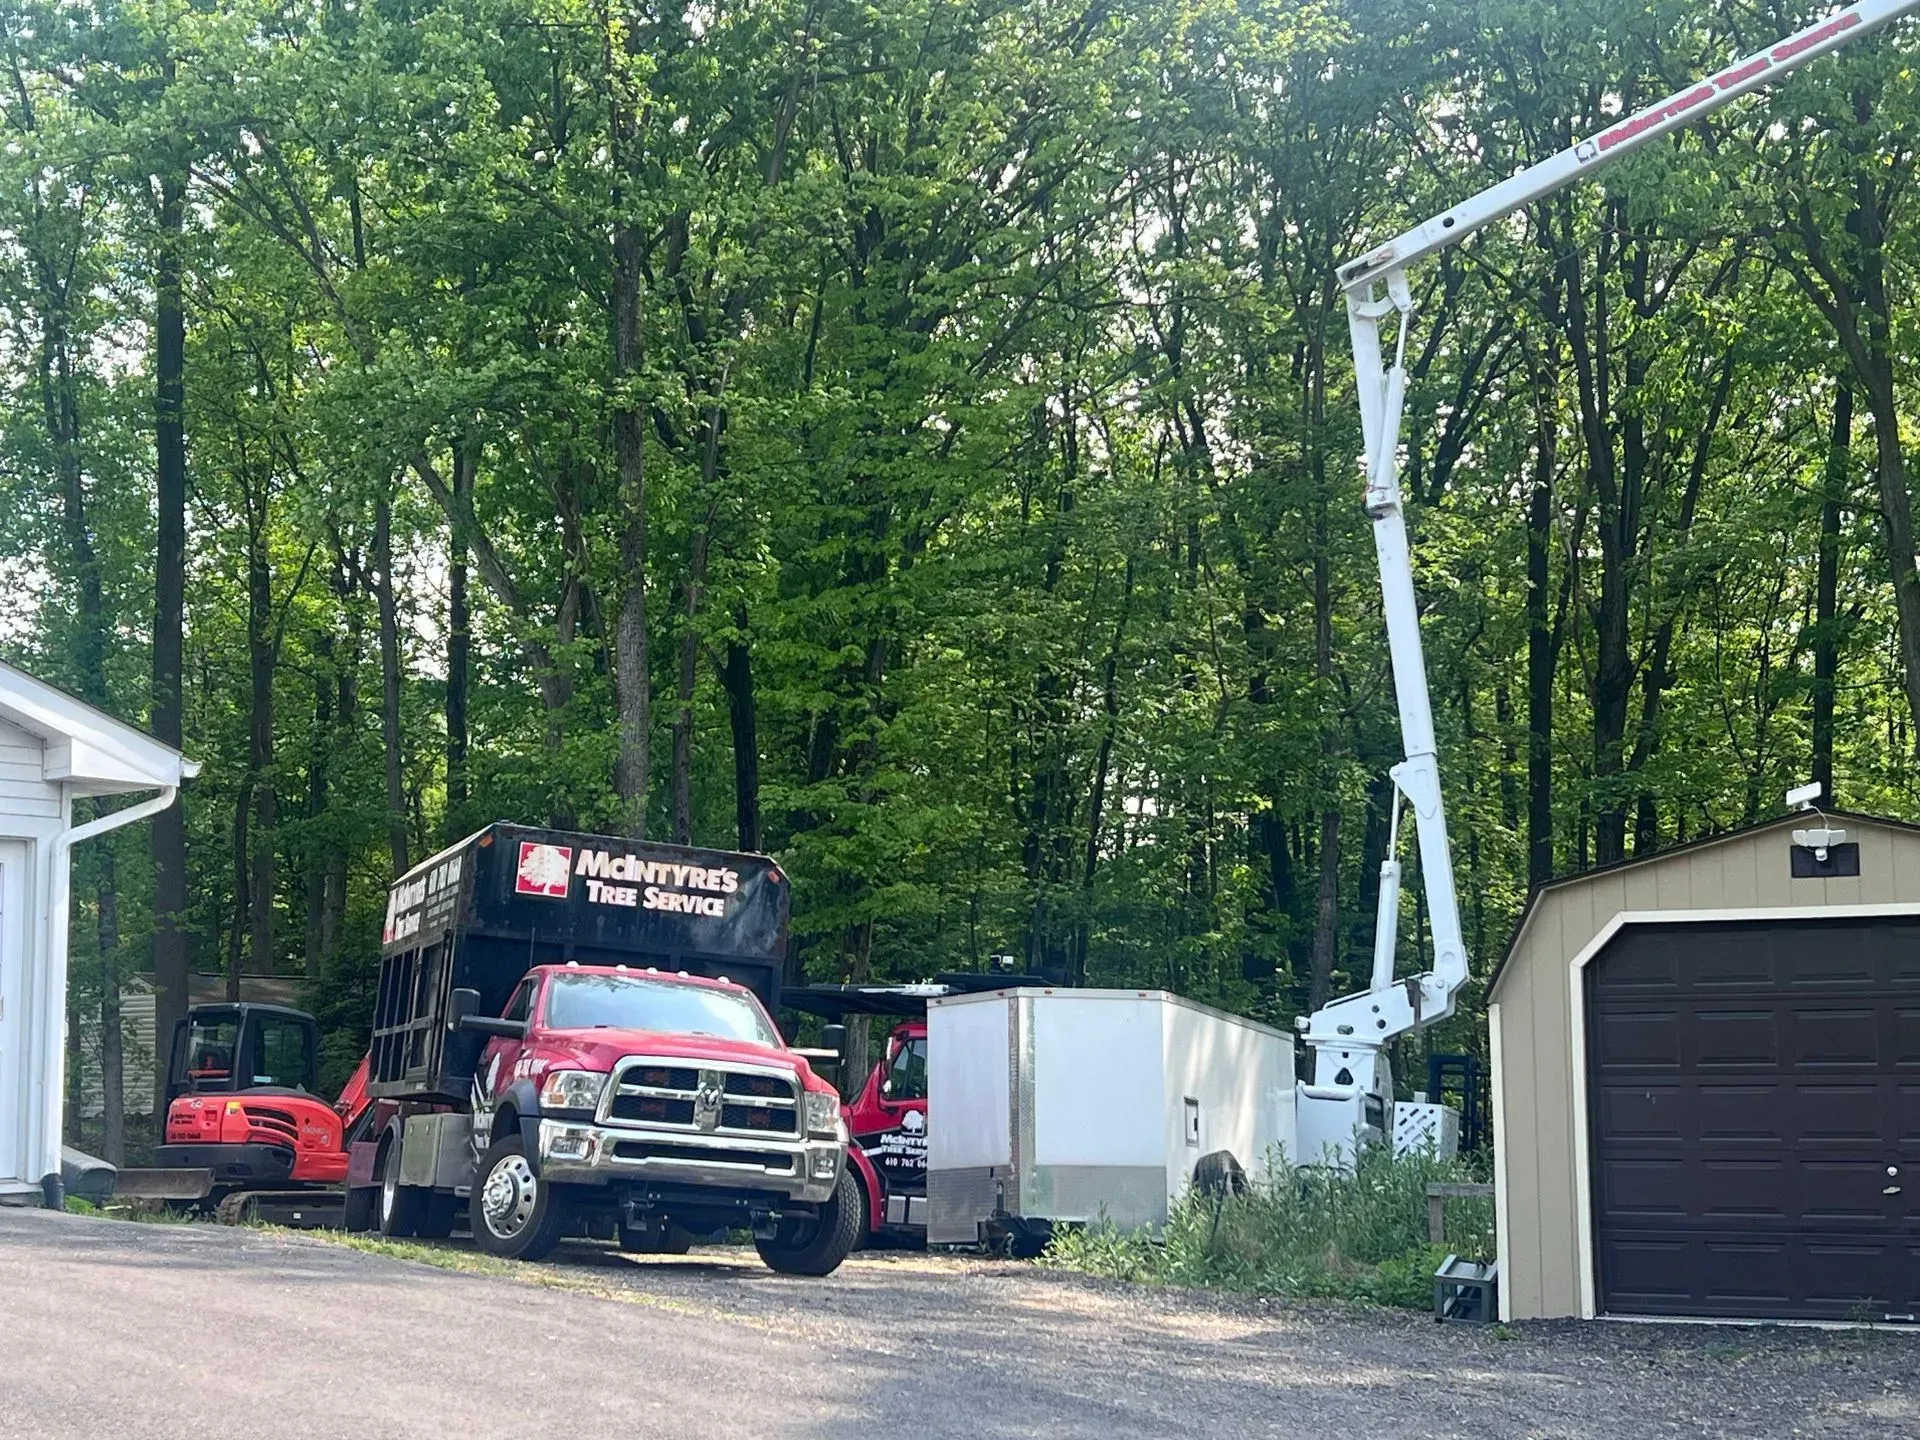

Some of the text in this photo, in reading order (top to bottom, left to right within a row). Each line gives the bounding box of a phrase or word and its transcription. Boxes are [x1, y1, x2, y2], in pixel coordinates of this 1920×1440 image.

[575, 849, 739, 894] McINTYRE'S
[586, 879, 725, 917] TREE SERVICE
